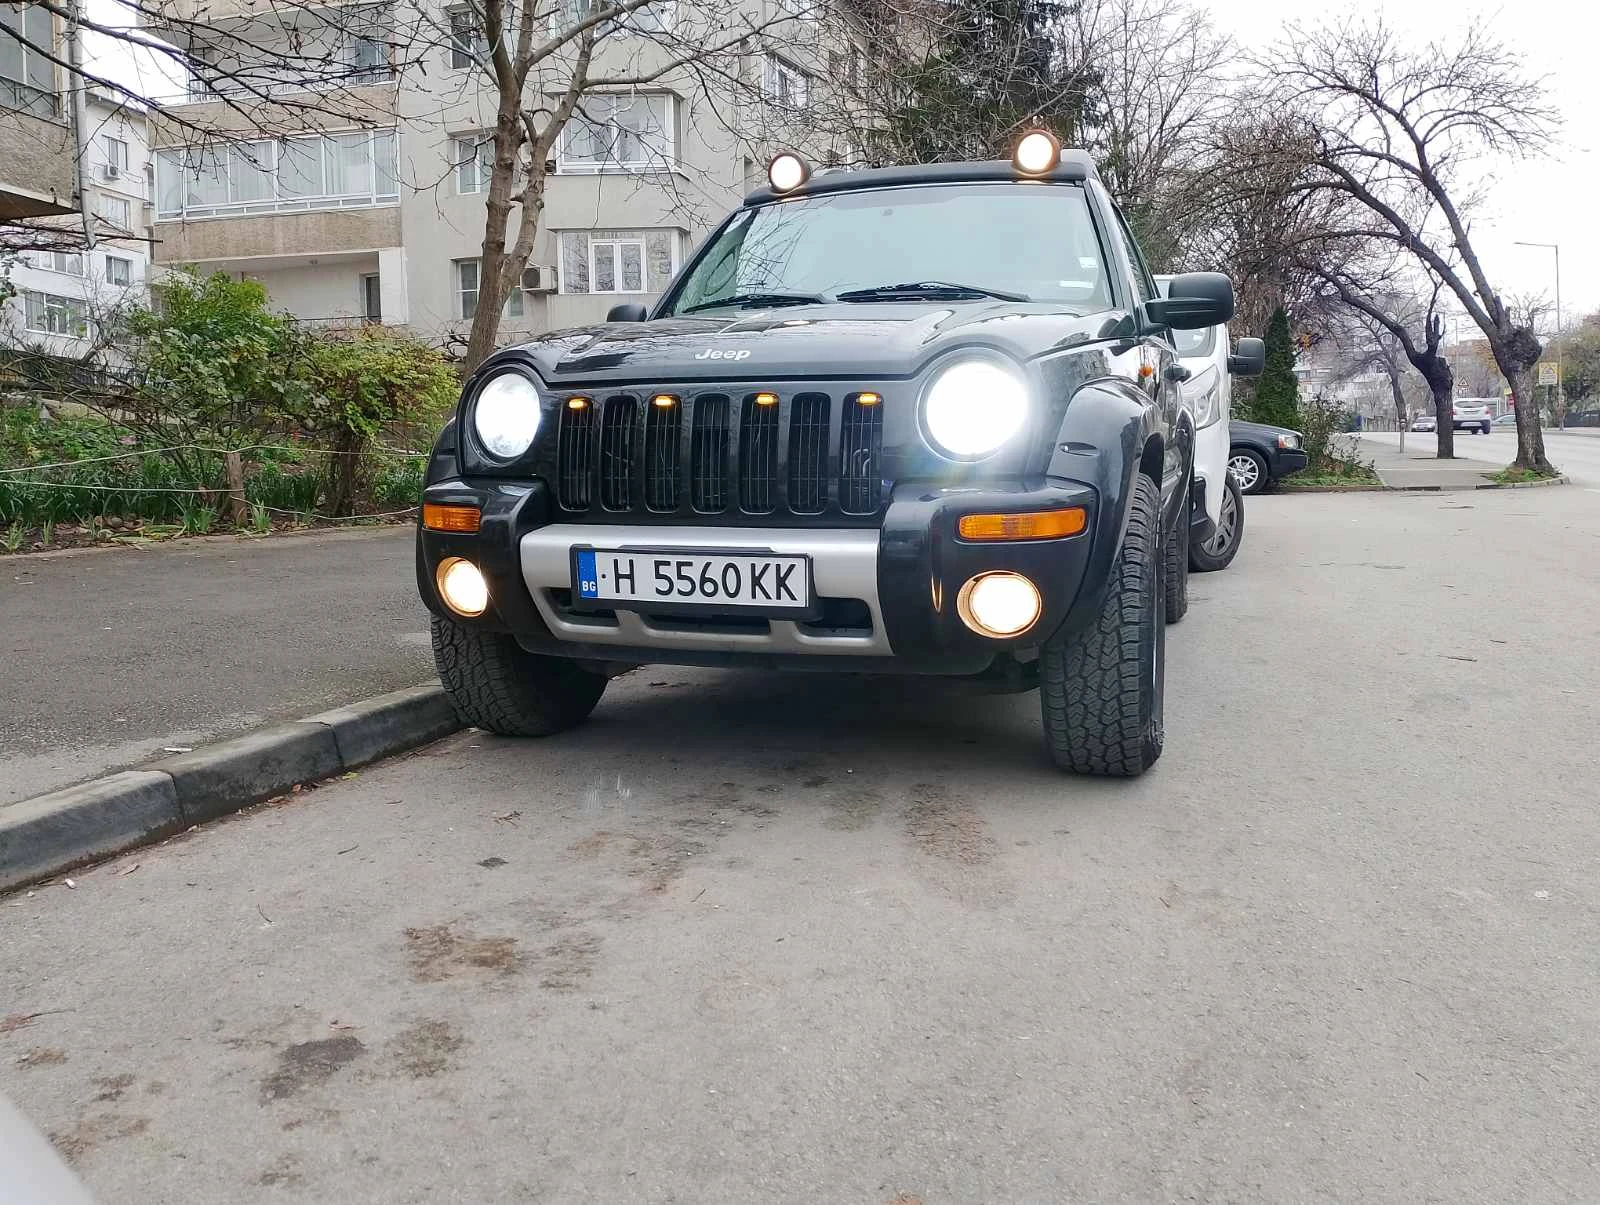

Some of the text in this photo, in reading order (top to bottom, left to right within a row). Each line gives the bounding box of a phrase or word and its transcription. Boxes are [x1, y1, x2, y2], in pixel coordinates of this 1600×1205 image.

[694, 348, 751, 360] Jeep
[613, 558, 636, 594] H
[582, 580, 596, 592] BG
